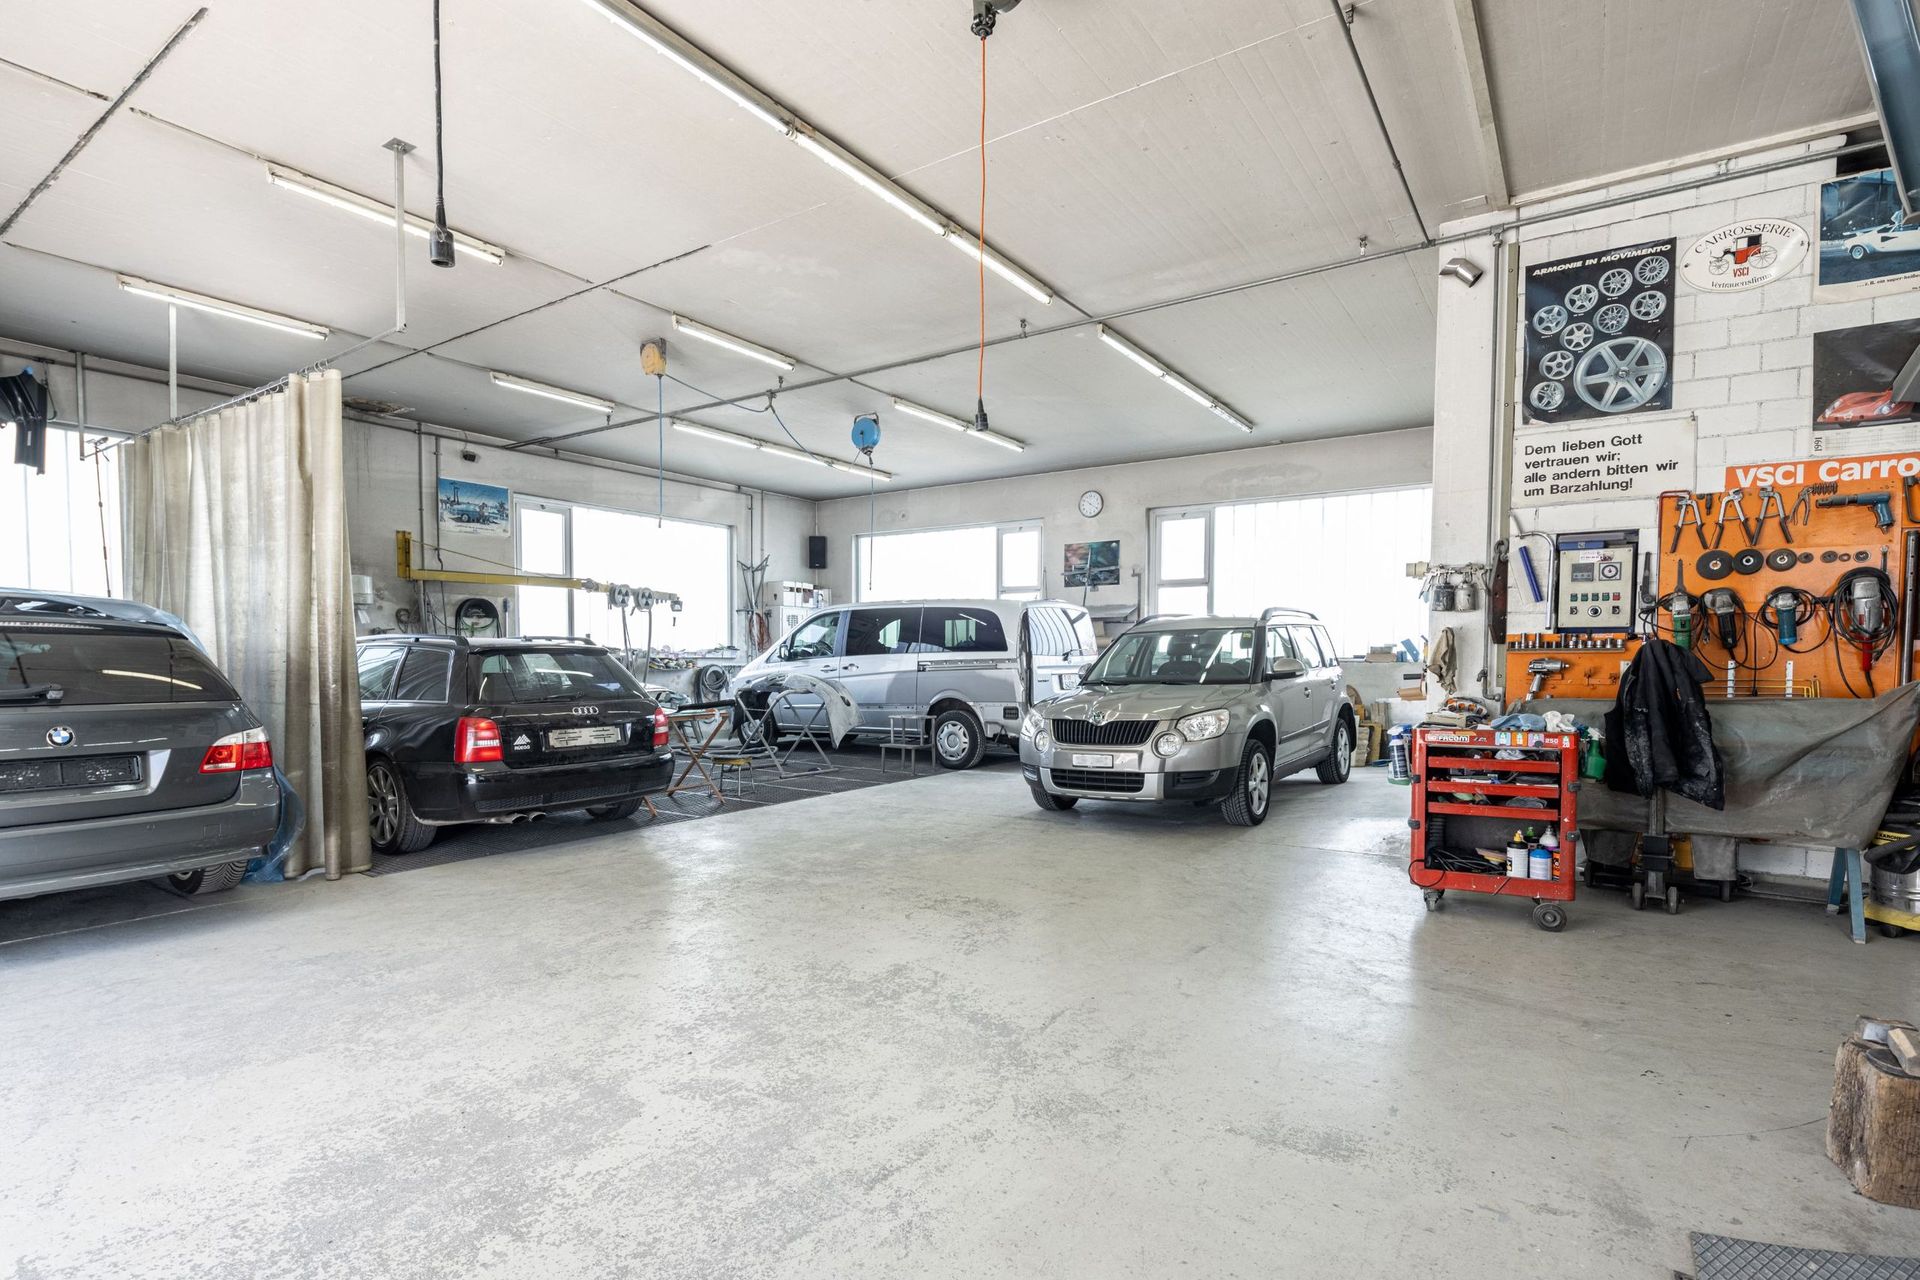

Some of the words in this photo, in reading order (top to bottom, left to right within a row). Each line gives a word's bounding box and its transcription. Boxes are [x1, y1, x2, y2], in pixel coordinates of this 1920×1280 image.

[1695, 223, 1795, 254] CARROSSERIE
[1532, 260, 1583, 277] ARMONIE
[1585, 257, 1598, 266] IN
[1600, 244, 1672, 263] MOVIMENTO
[1733, 266, 1750, 278] VSCI
[1524, 445, 1556, 456] Dem
[1562, 439, 1605, 452] lieben
[1611, 433, 1643, 447] Gott
[1814, 436, 1823, 452] 1991
[1523, 472, 1547, 483] alle
[1552, 468, 1600, 481] andern
[1606, 463, 1648, 476] bitten
[1656, 459, 1679, 471] wir
[1524, 455, 1589, 469] vertrauen
[1596, 451, 1621, 463] wir;
[1736, 463, 1805, 488] VSCI
[1523, 487, 1544, 497] um
[1550, 478, 1633, 495] Barzahlung!
